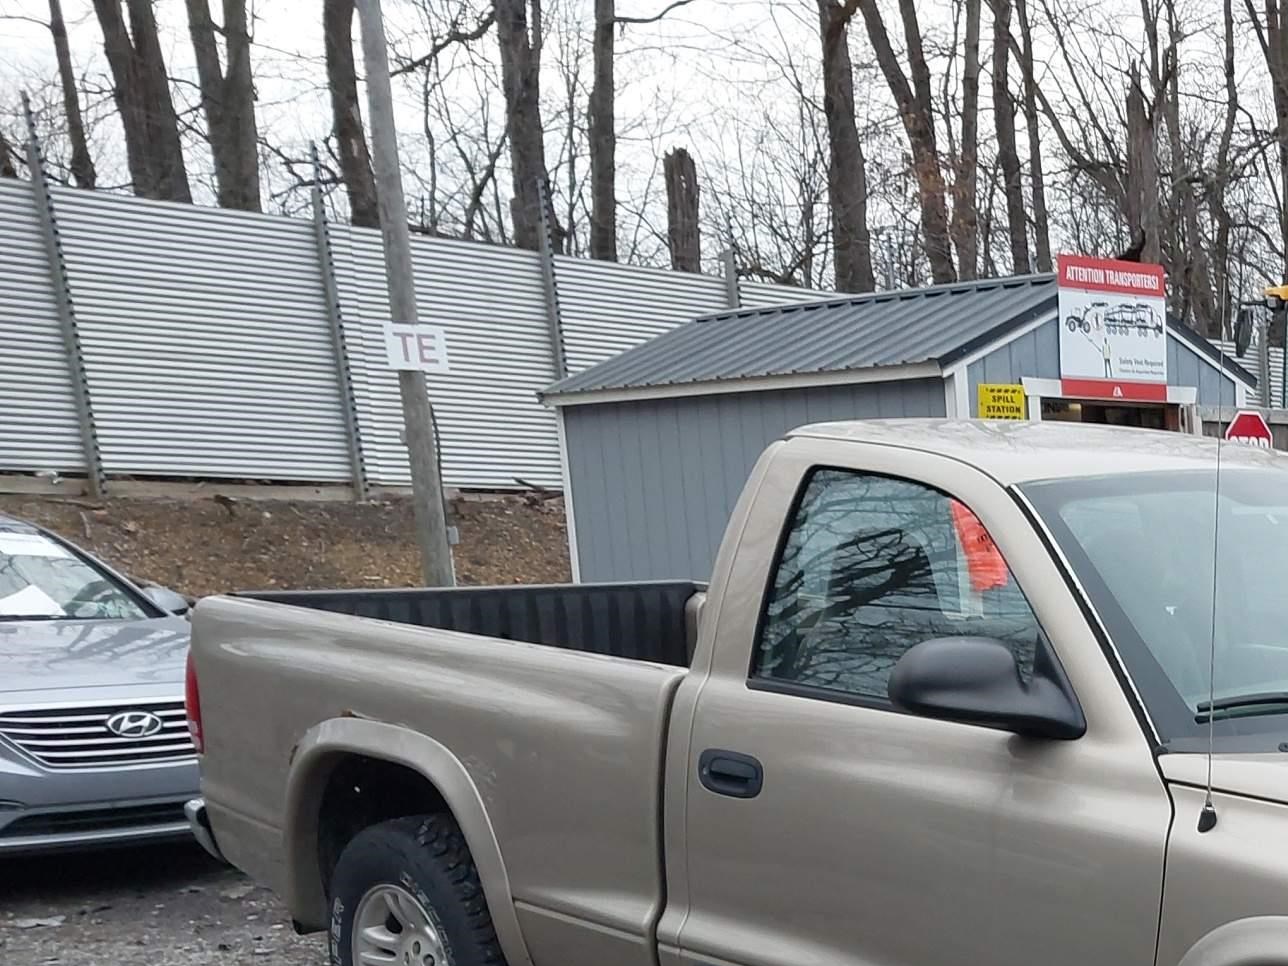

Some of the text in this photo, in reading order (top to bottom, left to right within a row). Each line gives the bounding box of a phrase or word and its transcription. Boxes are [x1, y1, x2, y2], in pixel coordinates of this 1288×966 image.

[1066, 265, 1159, 290] ATTENTION TRANSPORTERS!
[392, 332, 439, 364] TE
[991, 395, 1016, 403] SPILL
[986, 405, 1021, 413] STATION
